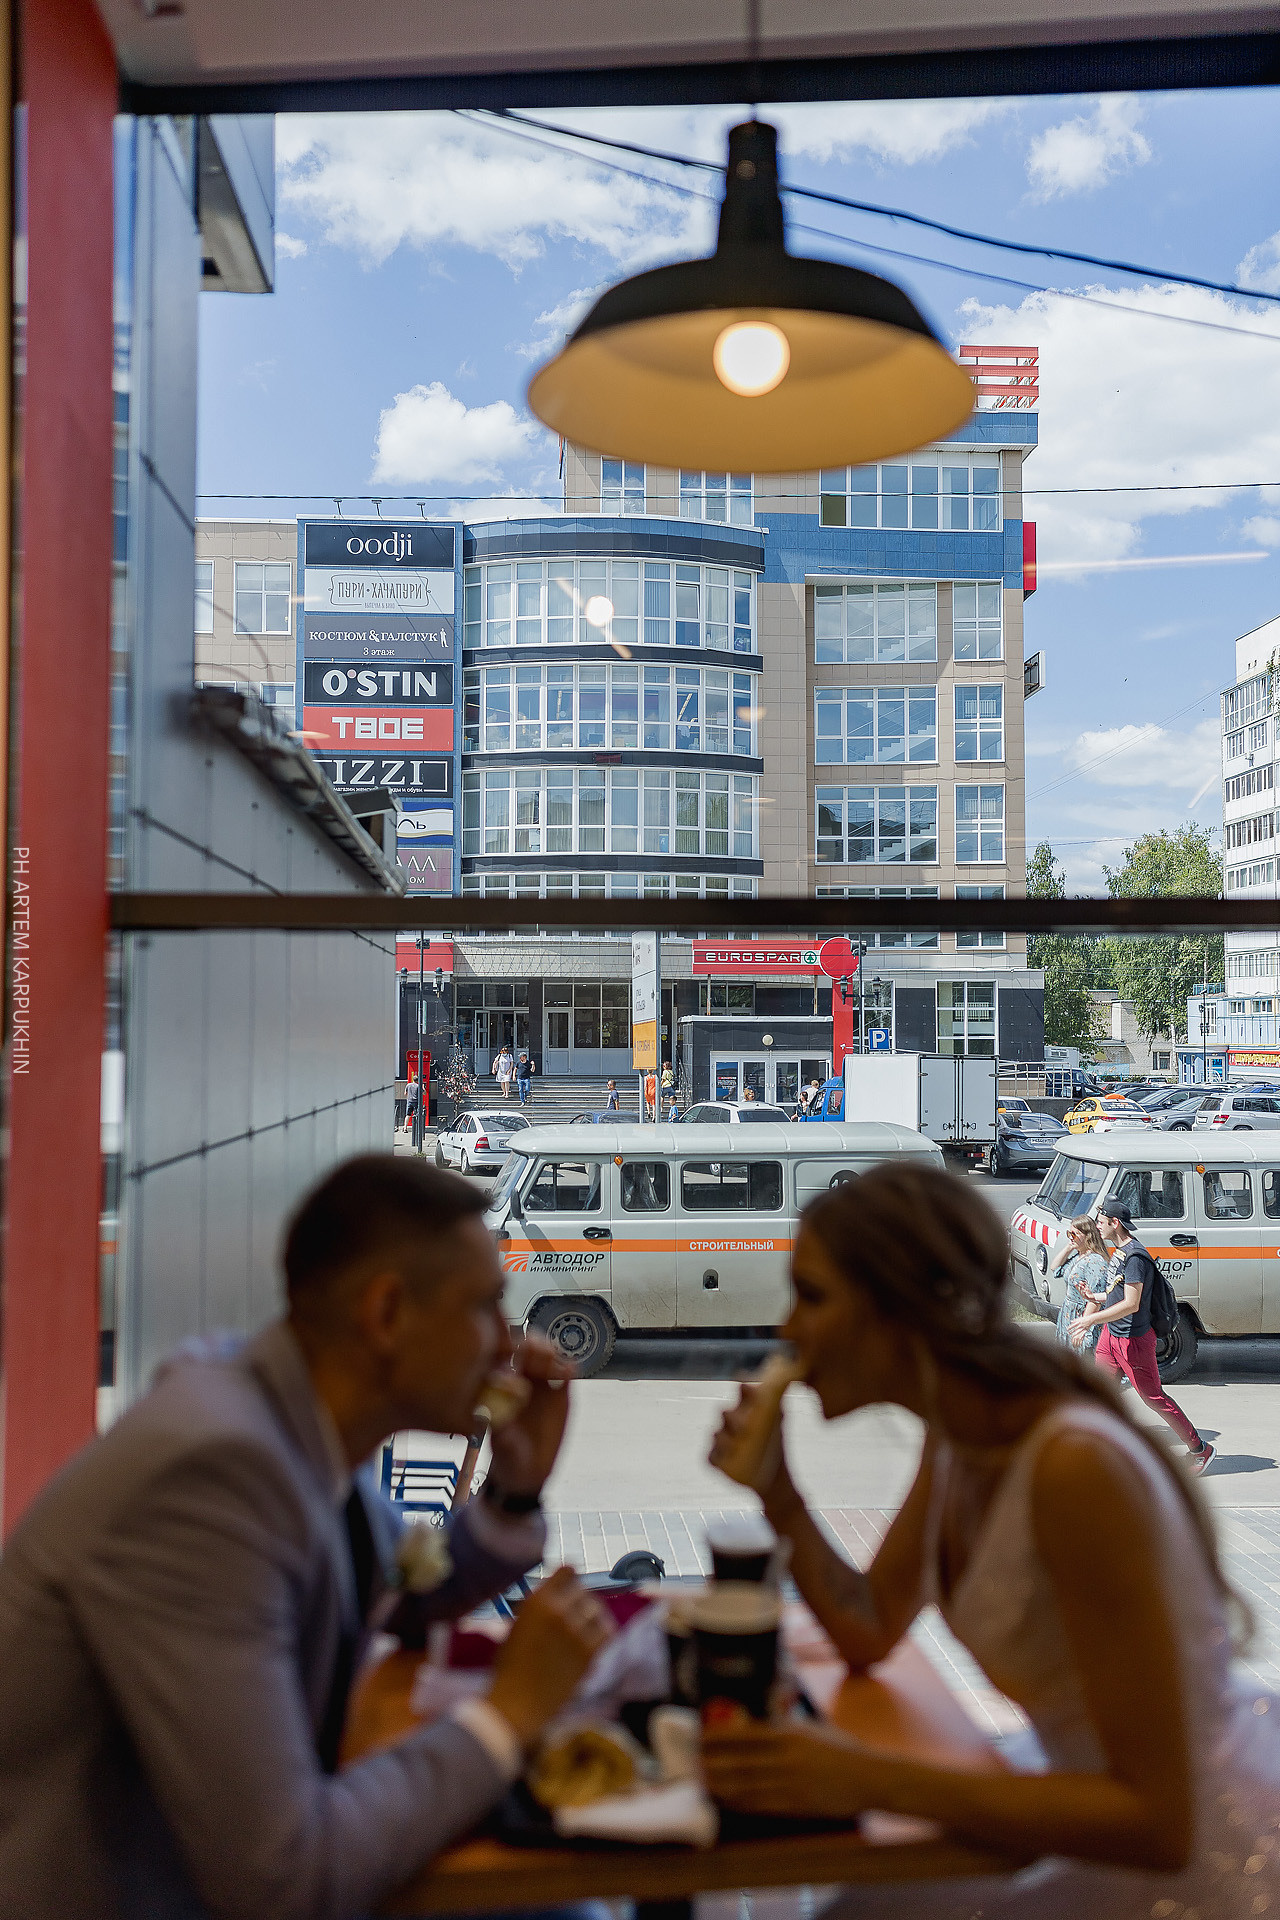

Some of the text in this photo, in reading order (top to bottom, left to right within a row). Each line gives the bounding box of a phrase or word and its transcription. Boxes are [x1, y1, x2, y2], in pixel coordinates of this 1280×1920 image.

[346, 531, 413, 562] oodji
[338, 582, 422, 599] ПУРИ ХАЧАПУРИ
[309, 631, 367, 641] КОСТЮМ
[381, 632, 438, 642] ГАЛСТУК
[363, 647, 395, 656] 3 этаж
[705, 952, 801, 962] EUROSPAR
[872, 1030, 886, 1048] P
[689, 1239, 774, 1251] СТРОИТЕЛЬНЫЙ
[532, 1253, 605, 1266] АВТОДОР
